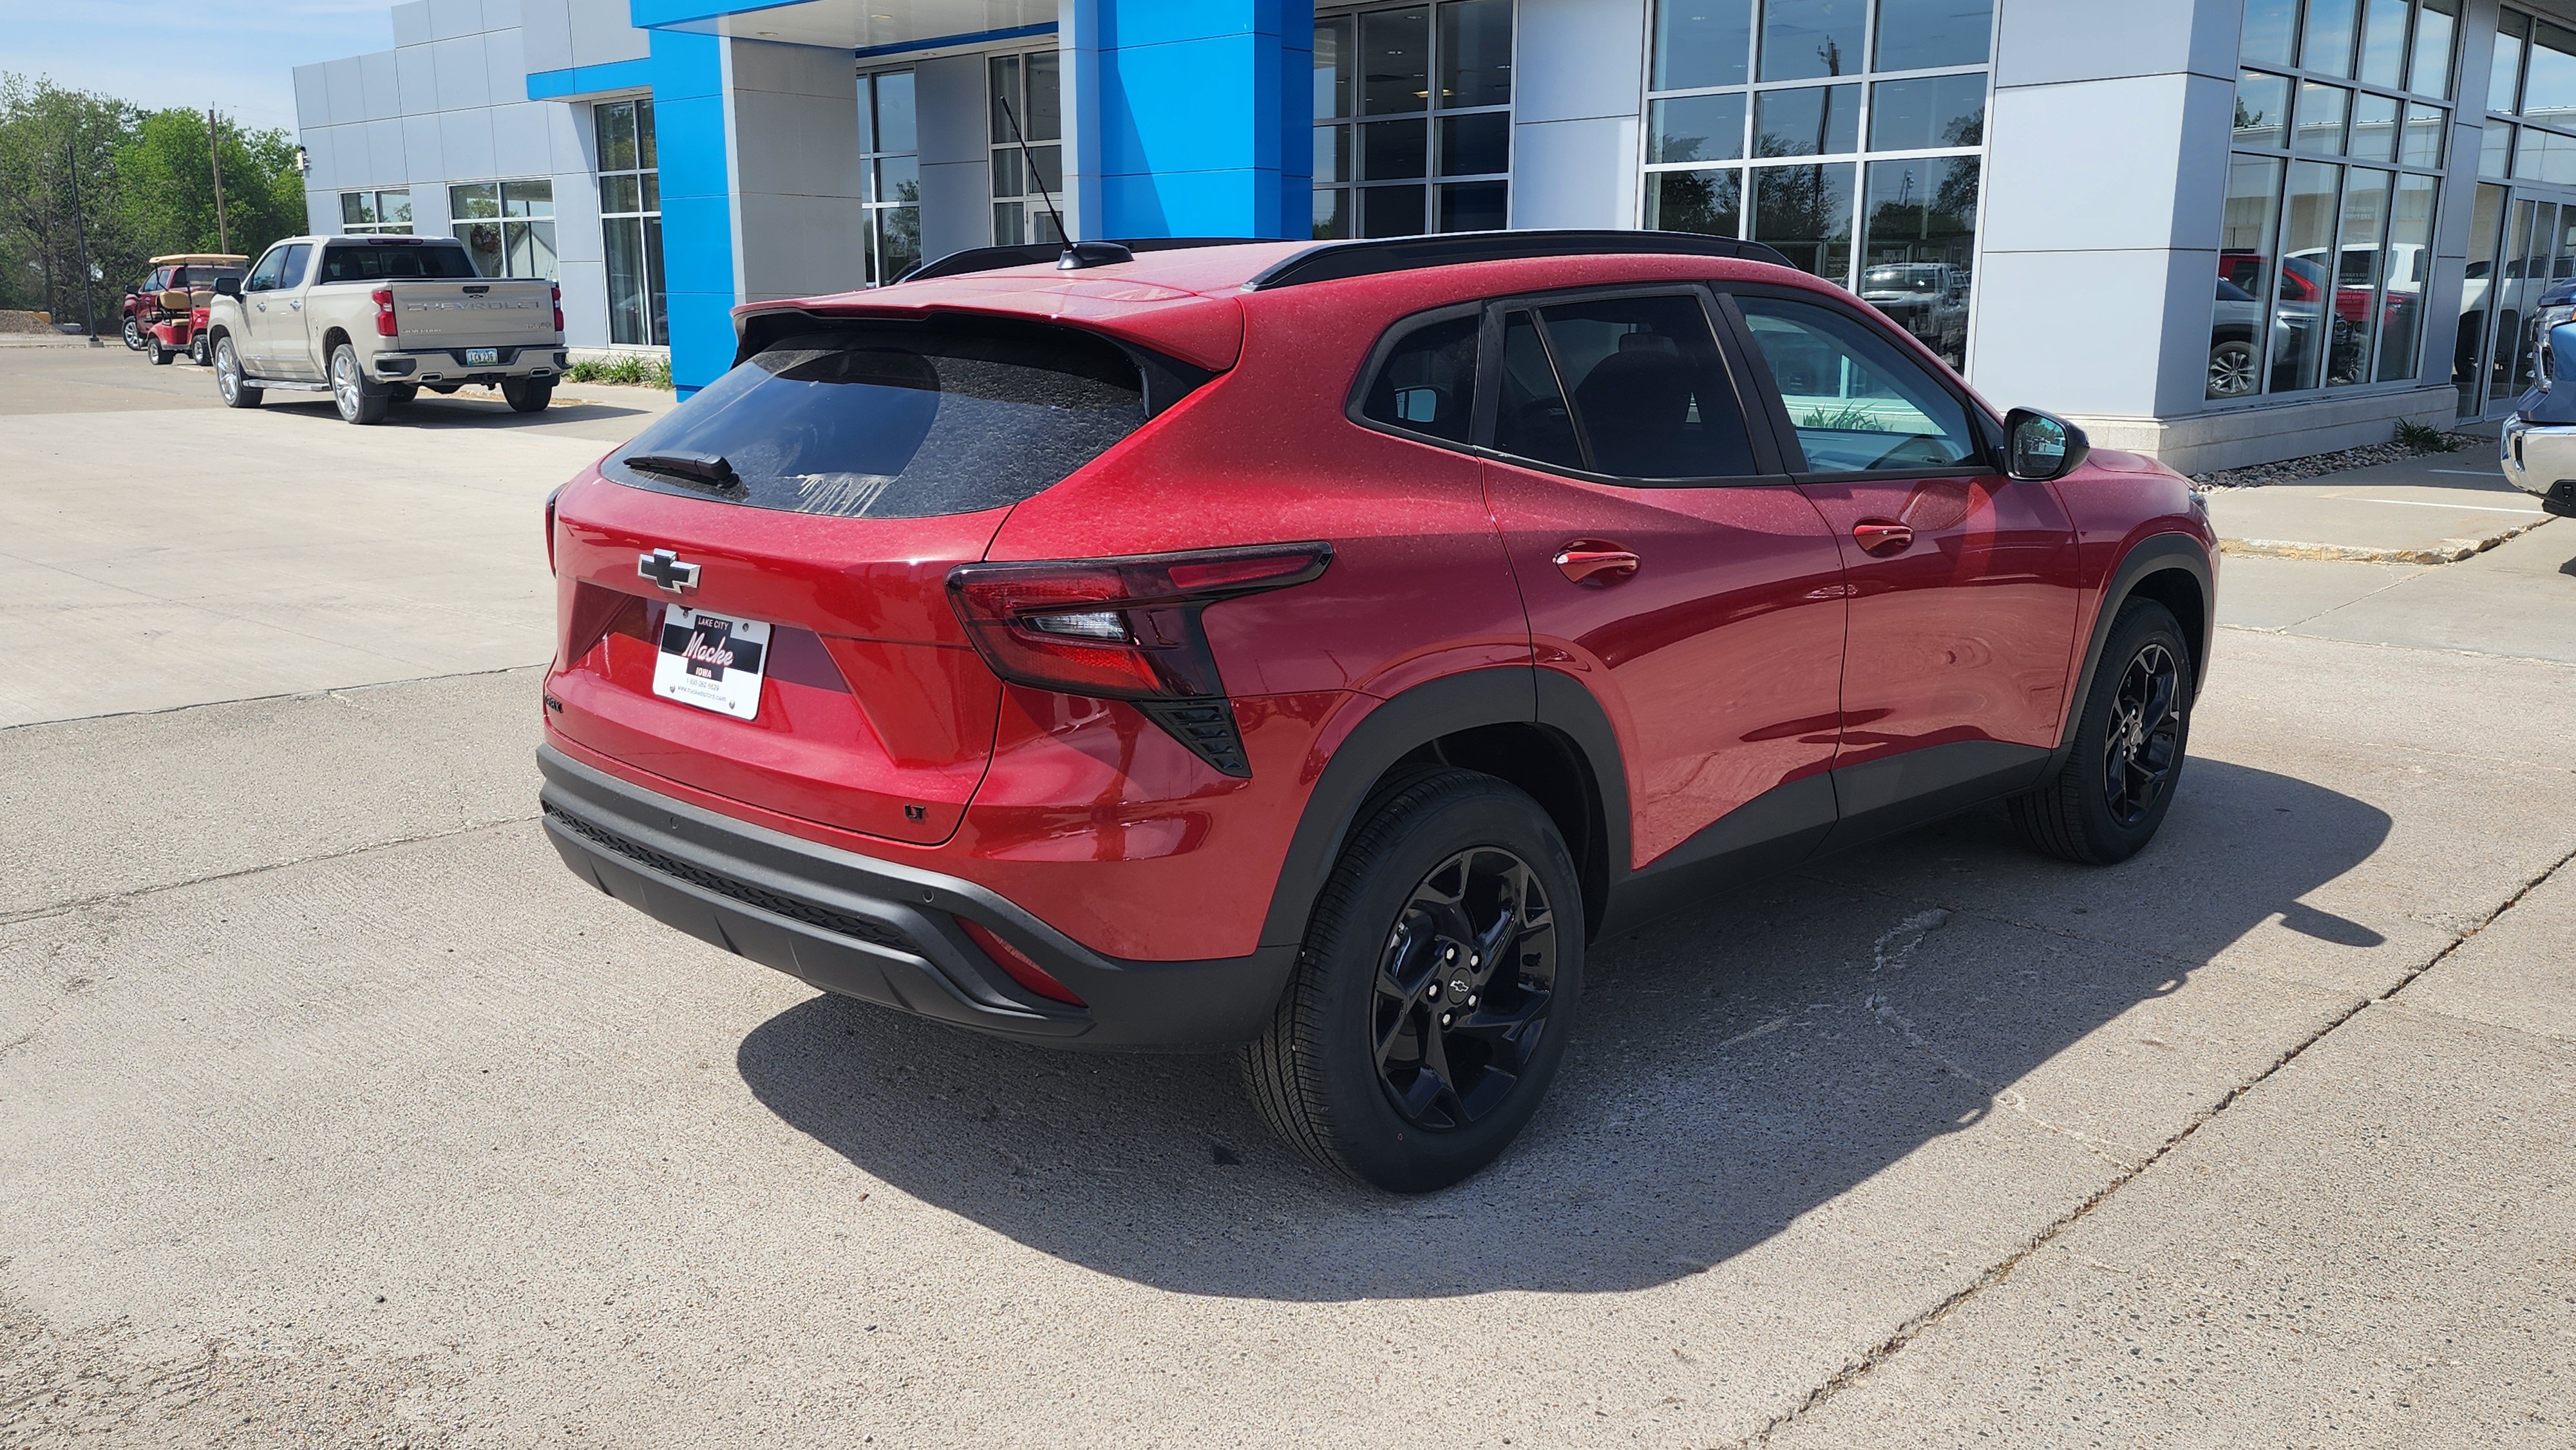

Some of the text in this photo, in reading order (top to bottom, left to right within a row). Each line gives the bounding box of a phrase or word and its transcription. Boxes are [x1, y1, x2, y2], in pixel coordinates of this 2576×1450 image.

[407, 301, 542, 311] CHEVROLET
[698, 617, 729, 630] LAKE CITY
[681, 630, 734, 666] Macke
[696, 666, 712, 678] IOWA
[904, 804, 925, 819] LT
